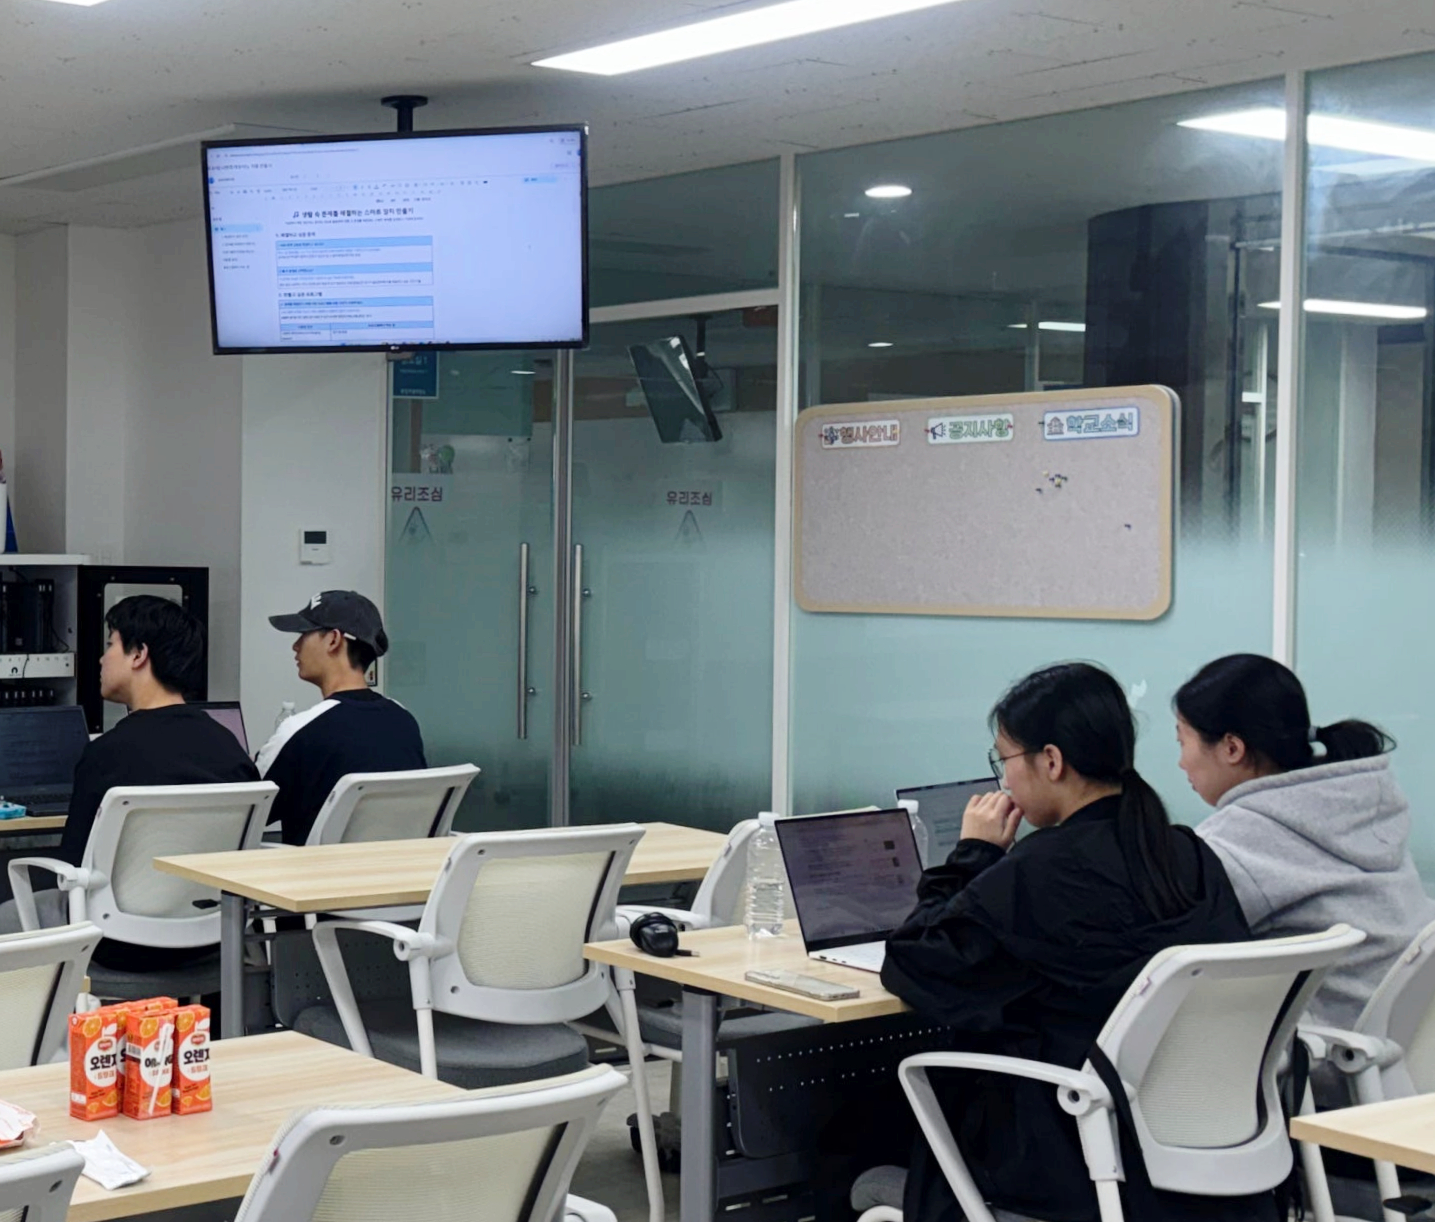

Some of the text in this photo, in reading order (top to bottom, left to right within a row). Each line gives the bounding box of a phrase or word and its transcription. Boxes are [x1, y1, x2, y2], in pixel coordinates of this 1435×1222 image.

[949, 419, 1010, 438] 공지사항
[1066, 412, 1134, 434] 학교소식
[840, 425, 898, 444] 행사안내
[390, 486, 443, 502] 유리조심
[666, 490, 712, 506] 유리조심
